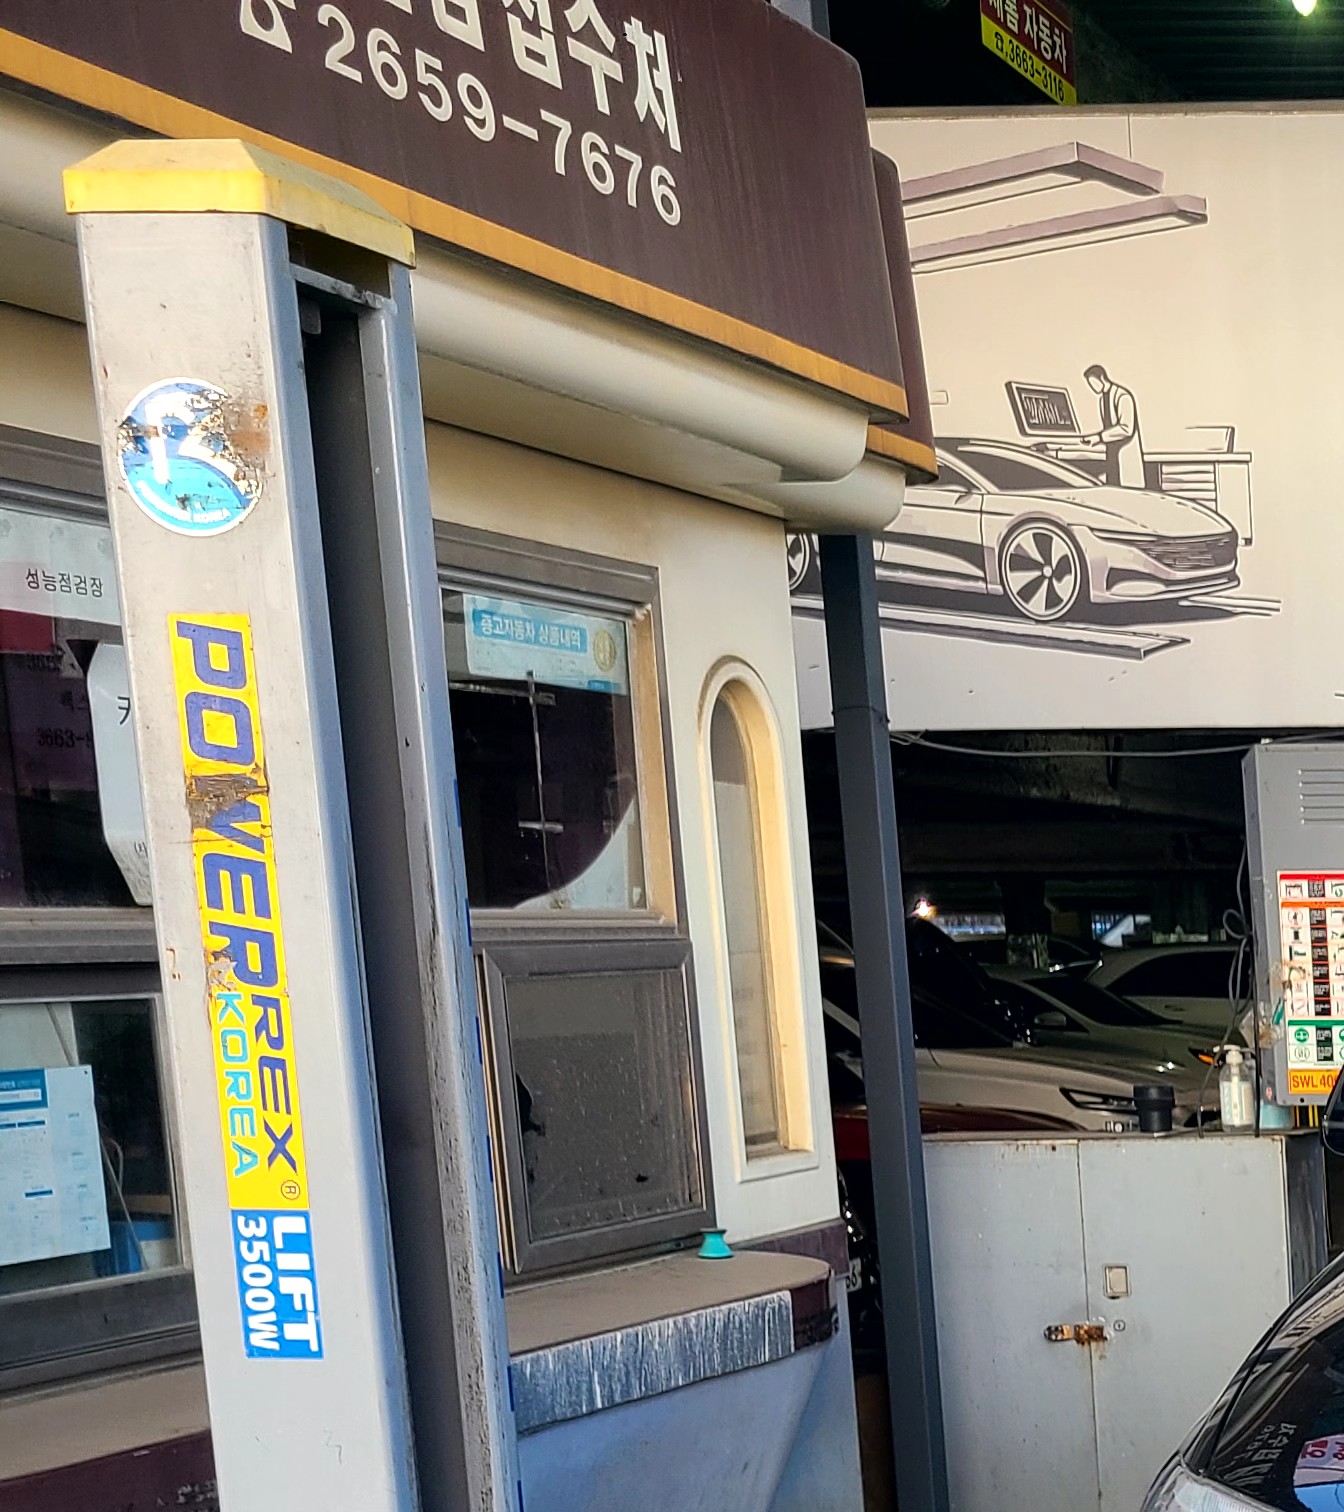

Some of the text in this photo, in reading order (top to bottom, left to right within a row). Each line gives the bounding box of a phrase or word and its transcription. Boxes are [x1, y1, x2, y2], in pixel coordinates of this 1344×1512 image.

[1023, 4, 1067, 74] 자동차
[317, 3, 682, 226] 2659-7676
[25, 567, 104, 598] 성능점검장
[216, 992, 260, 1179] KOREA
[1292, 1075, 1318, 1089] SWL
[237, 1214, 281, 1352] 3500W
[272, 1215, 320, 1353] LIFT
